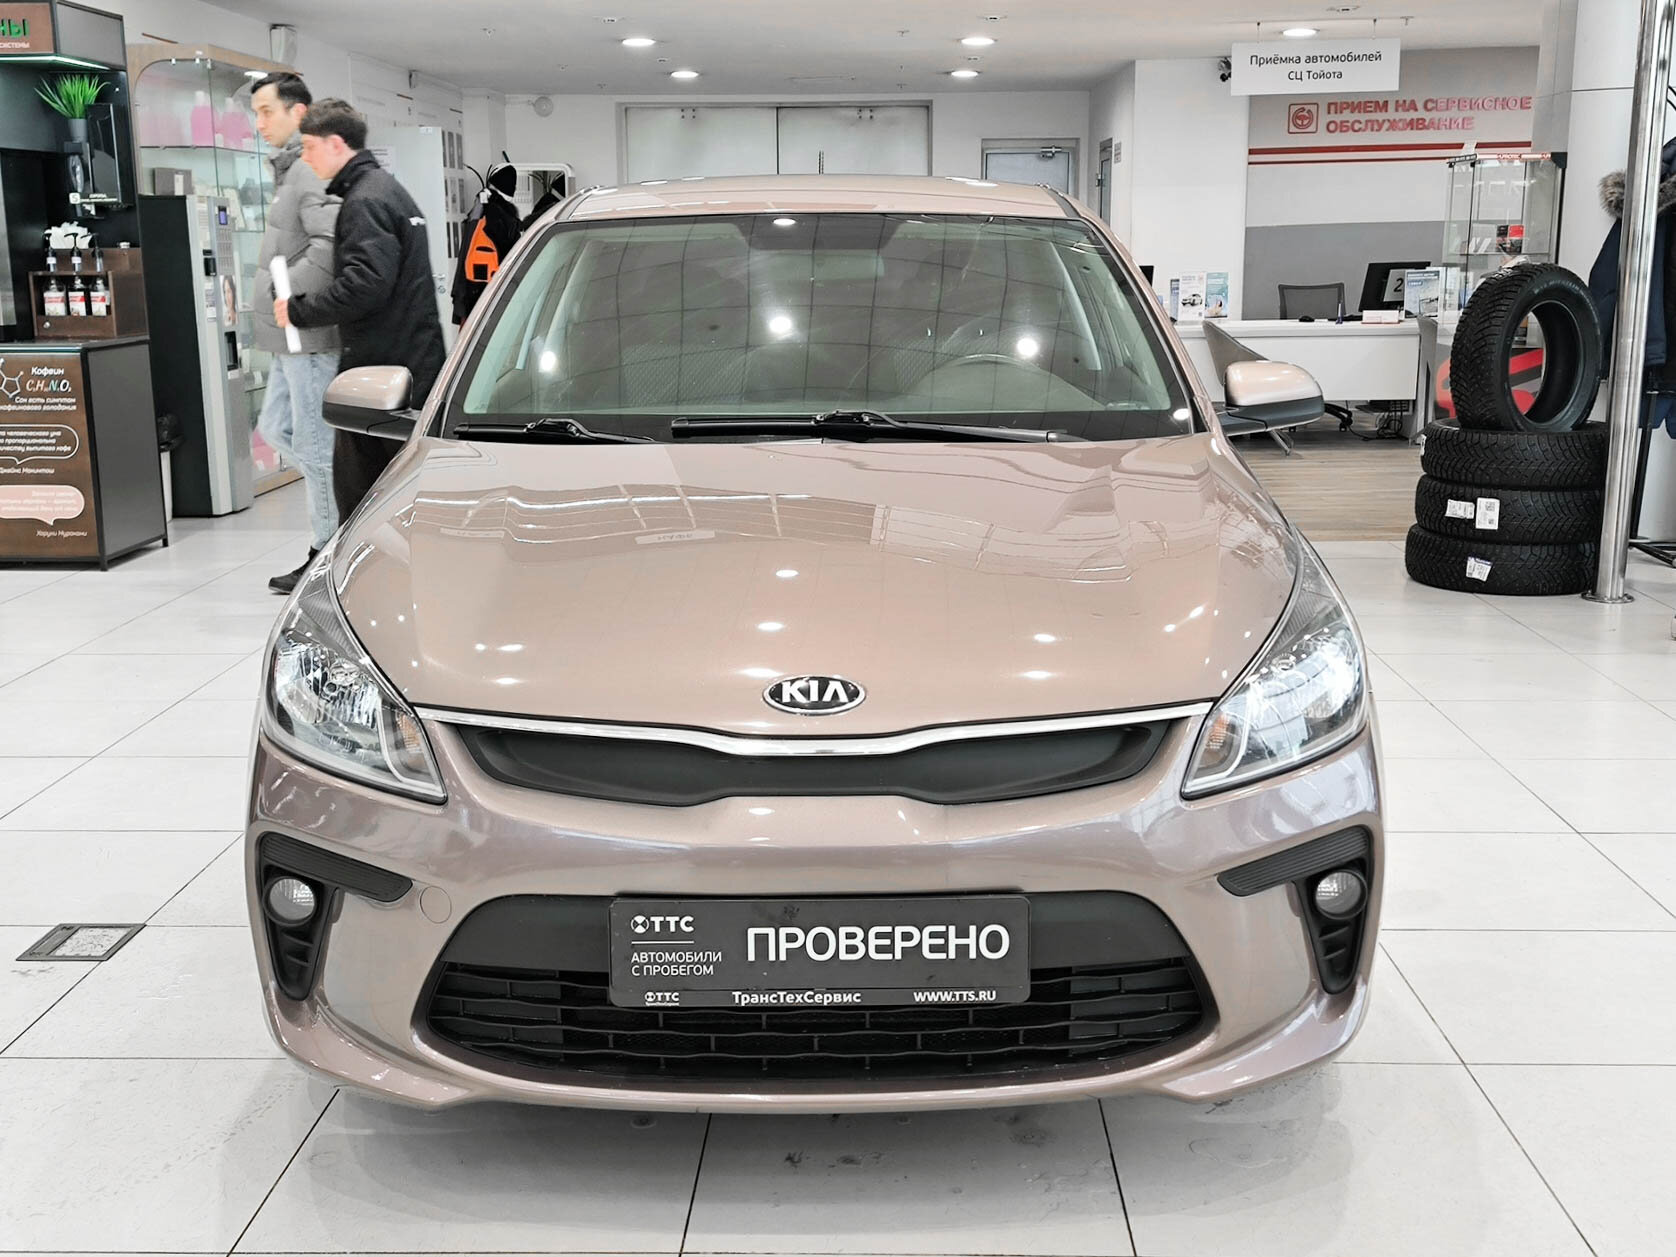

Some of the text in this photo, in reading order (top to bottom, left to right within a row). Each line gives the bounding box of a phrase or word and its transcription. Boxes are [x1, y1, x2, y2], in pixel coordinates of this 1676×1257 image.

[1250, 51, 1382, 67] Приёмка автомобилей
[1287, 69, 1343, 82] СЦ Тойота
[1327, 96, 1533, 114] ПРИЕМ НА СЕРВИСНОЕ
[1326, 116, 1475, 133] ОБСЛУЖИВАНИЕ
[1393, 277, 1404, 293] 2
[781, 679, 849, 704] KIA
[650, 915, 694, 933] ТТС
[747, 924, 1010, 961] ПРОВЕРЕНО
[631, 951, 722, 963] АВТОМОБИЛИ
[631, 964, 714, 976] С ПРОБЕГОМ
[732, 991, 862, 1006] ТрансТехСервис
[913, 989, 997, 1002] WWW.TTS.RU
